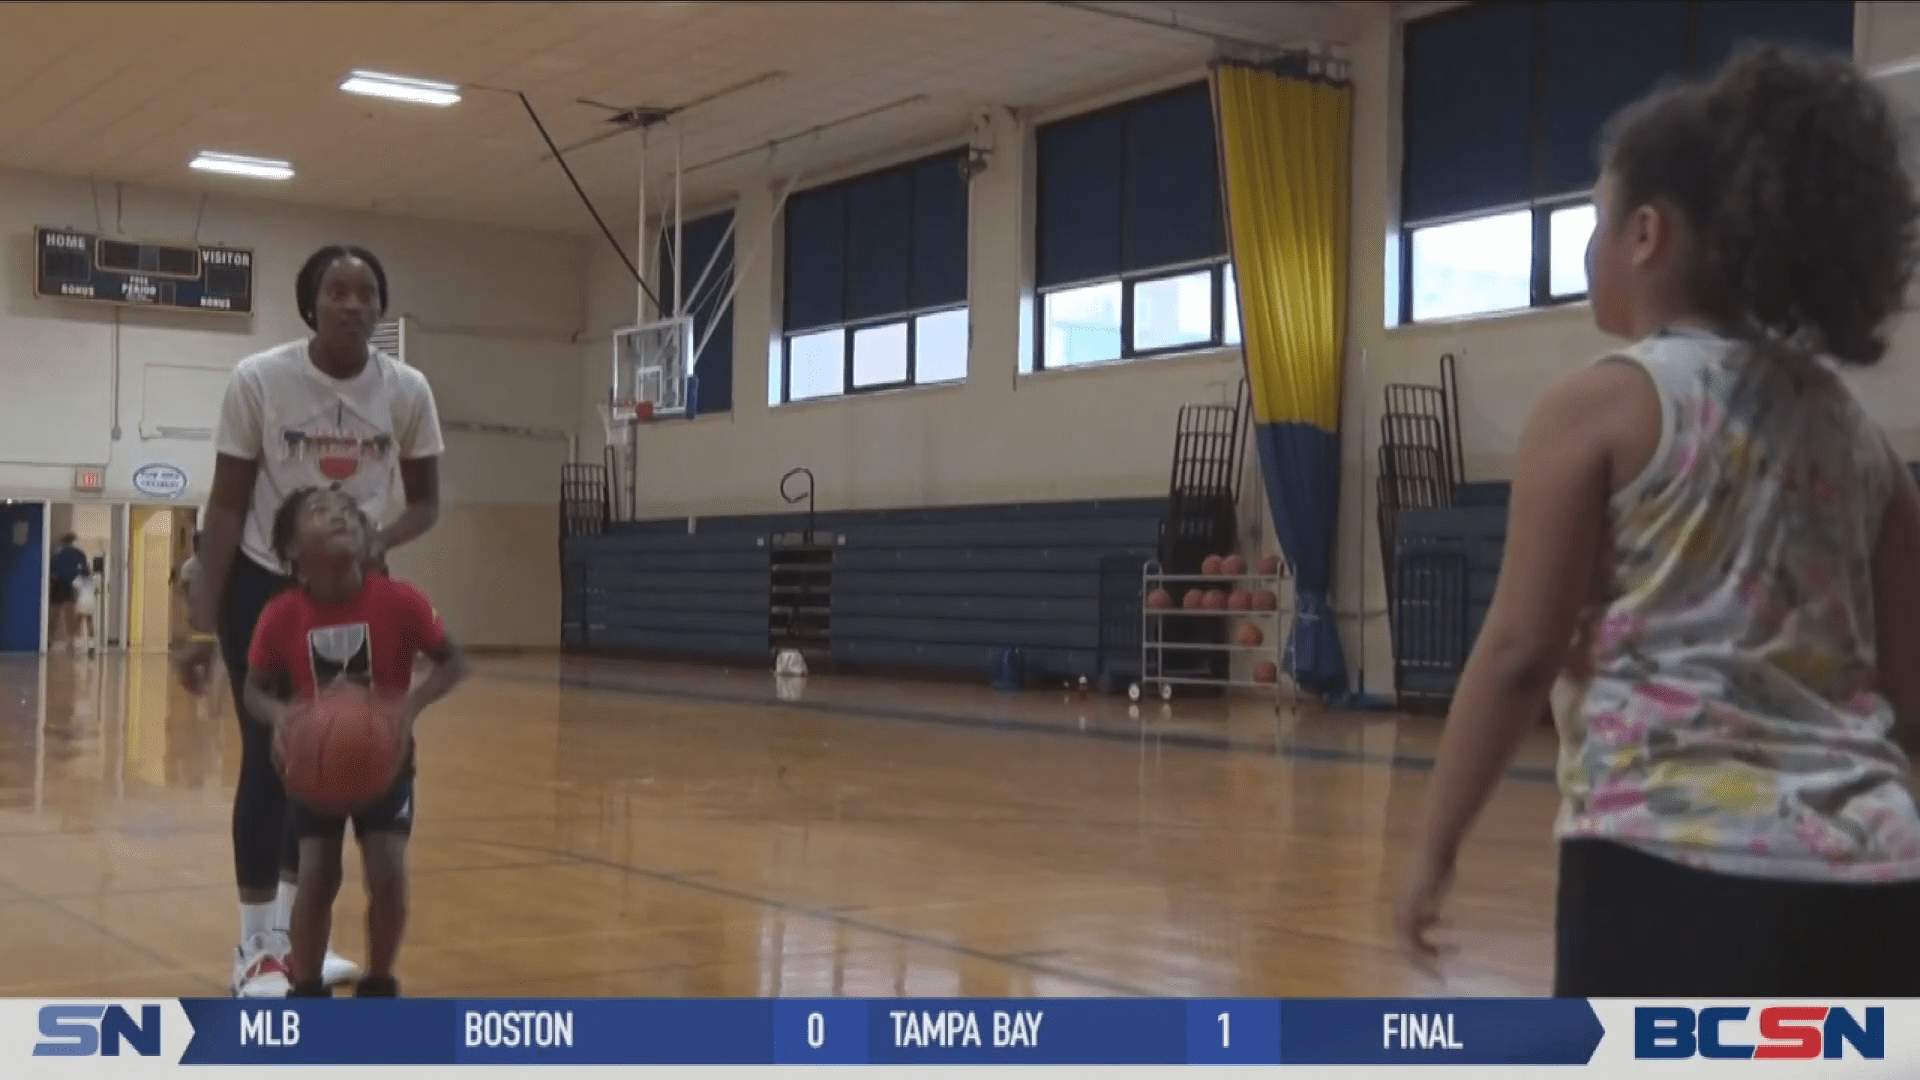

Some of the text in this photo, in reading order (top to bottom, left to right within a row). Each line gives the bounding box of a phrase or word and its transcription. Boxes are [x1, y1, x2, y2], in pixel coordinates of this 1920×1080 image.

[45, 233, 86, 249] HOME
[202, 250, 250, 266] VISITOR
[60, 283, 95, 296] BONUS
[121, 283, 157, 295] PERIOD
[200, 296, 231, 308] BONUS
